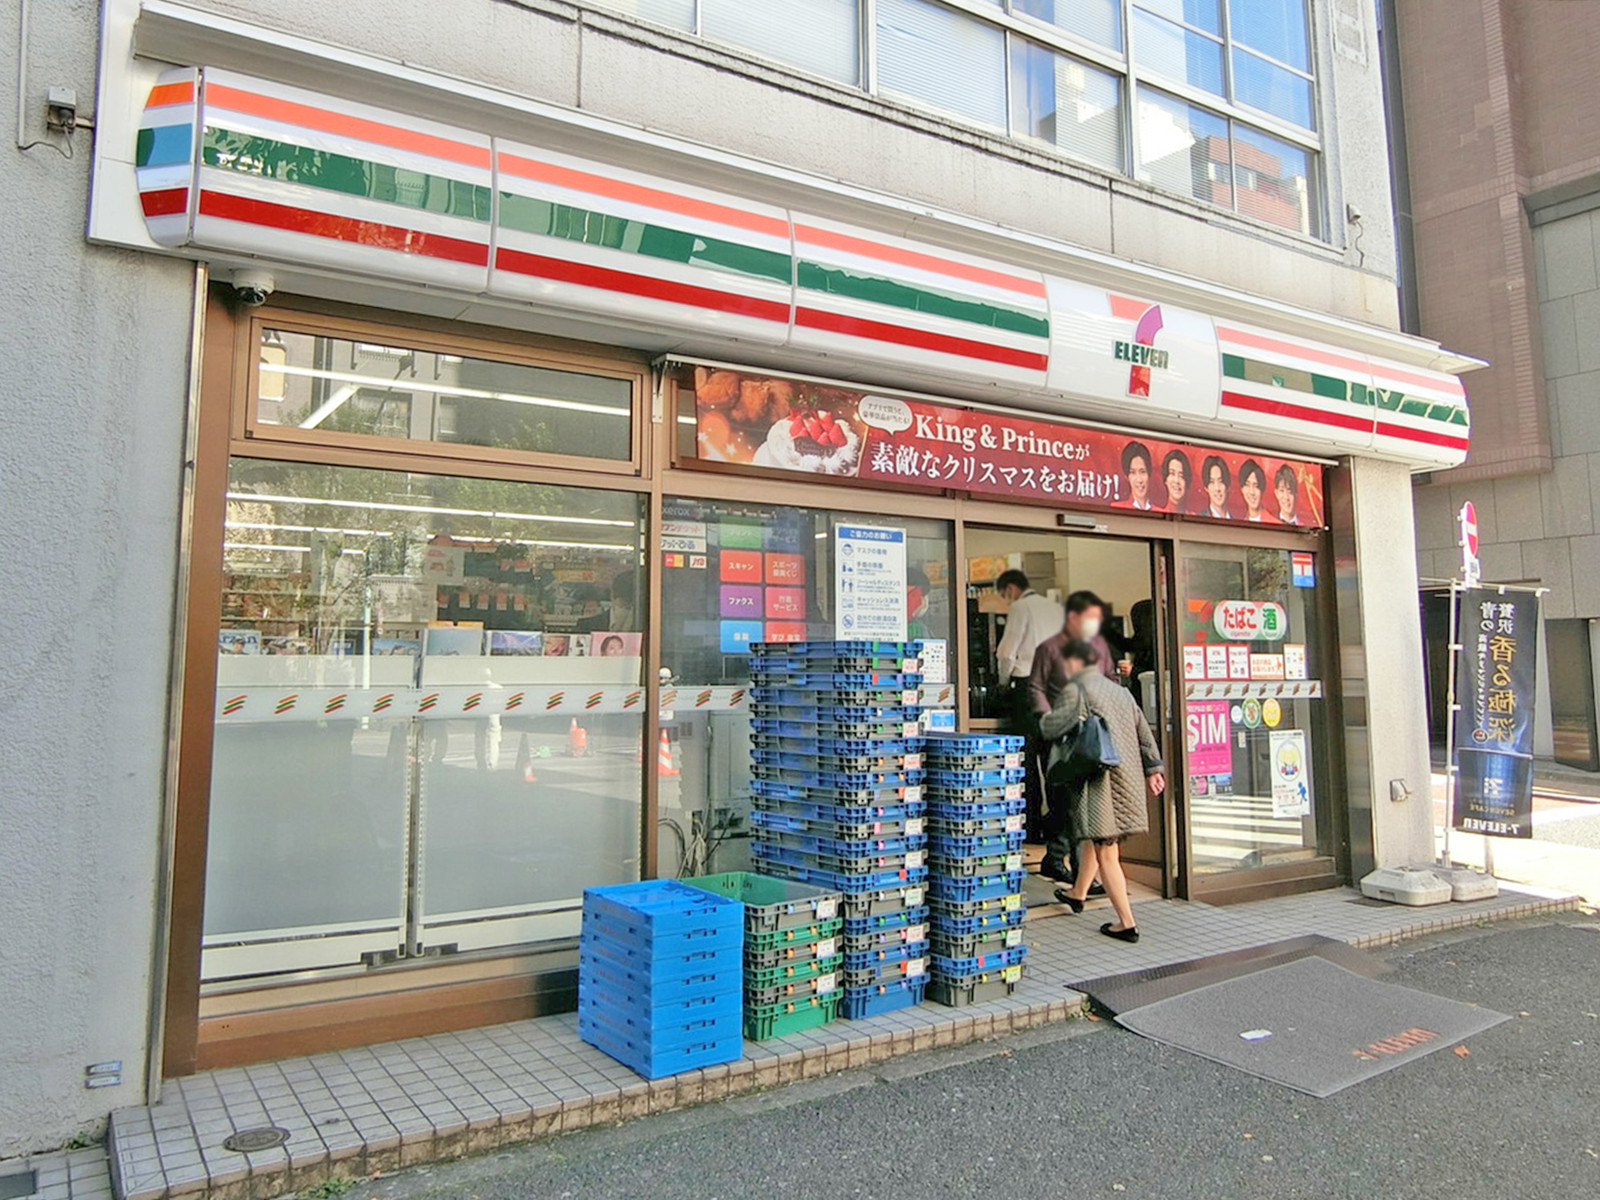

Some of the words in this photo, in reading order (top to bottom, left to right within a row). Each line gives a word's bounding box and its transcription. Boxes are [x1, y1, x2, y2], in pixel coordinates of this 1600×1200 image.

[914, 413, 977, 452] King
[979, 423, 998, 449] &
[870, 441, 1120, 500] 素敵なクリスマスをお届け!
[728, 562, 754, 571] スキャン
[1223, 606, 1257, 630] たばこ
[1263, 608, 1277, 630] 酒
[1186, 713, 1227, 747] SIM
